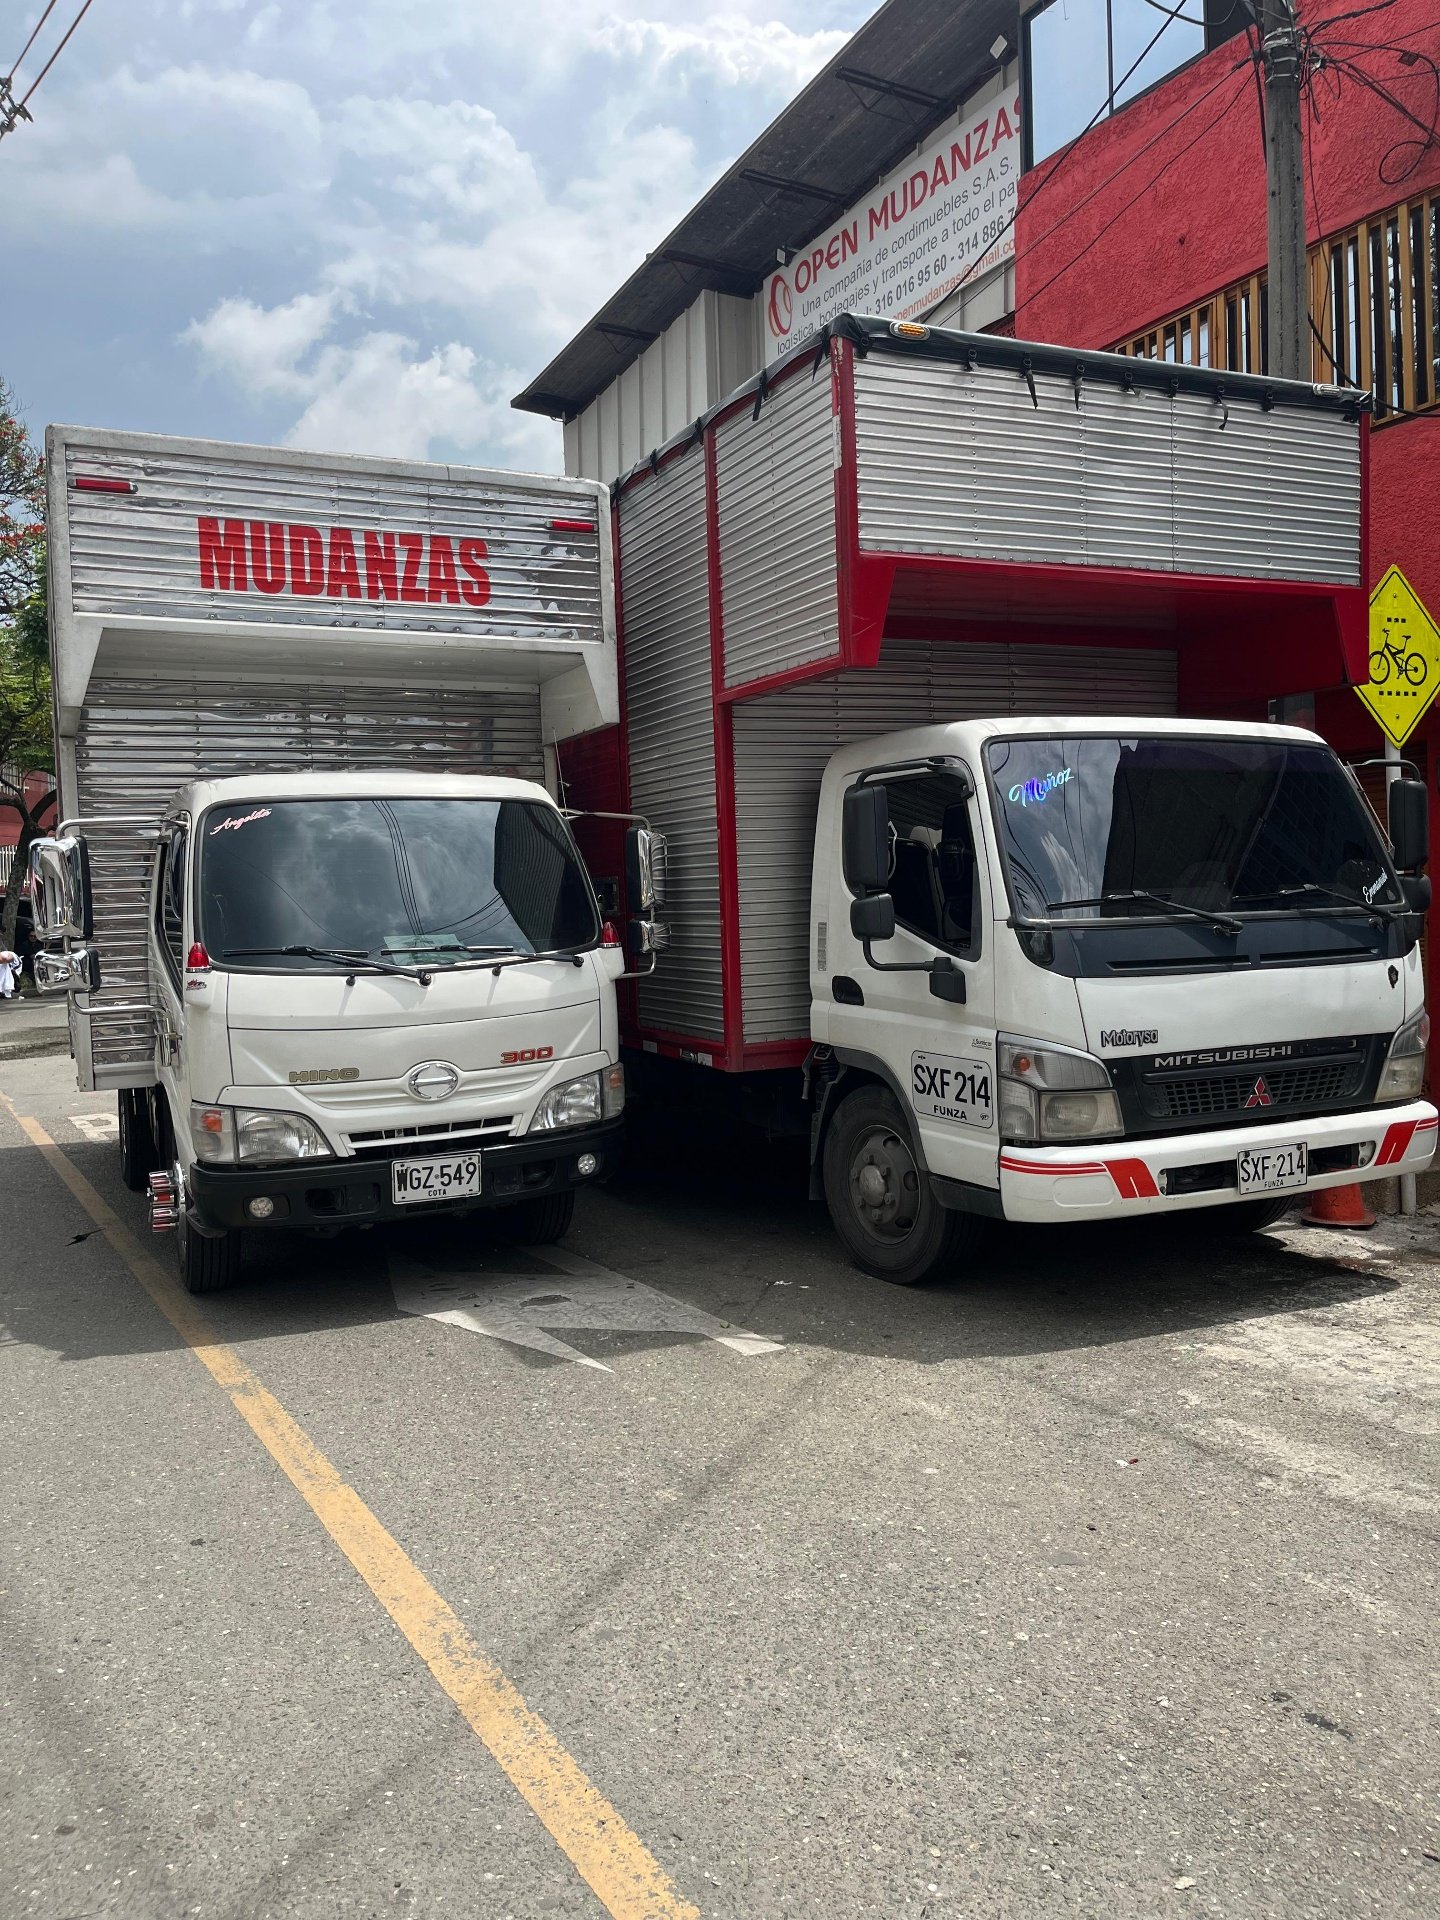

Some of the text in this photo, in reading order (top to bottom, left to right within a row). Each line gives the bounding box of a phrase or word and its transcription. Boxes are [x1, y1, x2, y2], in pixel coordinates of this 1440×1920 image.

[802, 156, 1013, 317] Una compañía de cordimuebles S.A.S.
[872, 276, 879, 294] y
[881, 237, 938, 284] transporte
[941, 228, 949, 243] a
[952, 206, 980, 235] todo
[983, 191, 995, 213] el
[795, 220, 858, 293] OPEN
[875, 290, 893, 315] 316
[896, 276, 915, 301] 016
[917, 264, 931, 287] 95
[933, 253, 947, 276] 60
[957, 231, 979, 260] 314
[982, 214, 1005, 244] 886
[198, 516, 491, 606] MUDANZAS
[1008, 767, 1075, 807] Muñoz
[1101, 1029, 1159, 1047] Motorysa
[500, 1046, 554, 1064] 300
[1154, 1045, 1292, 1068] MITSUBISHI
[288, 1067, 360, 1083] HINO
[933, 1104, 967, 1120] FUNZA
[428, 1188, 447, 1197] COTA
[1264, 1179, 1284, 1188] FUNZA
